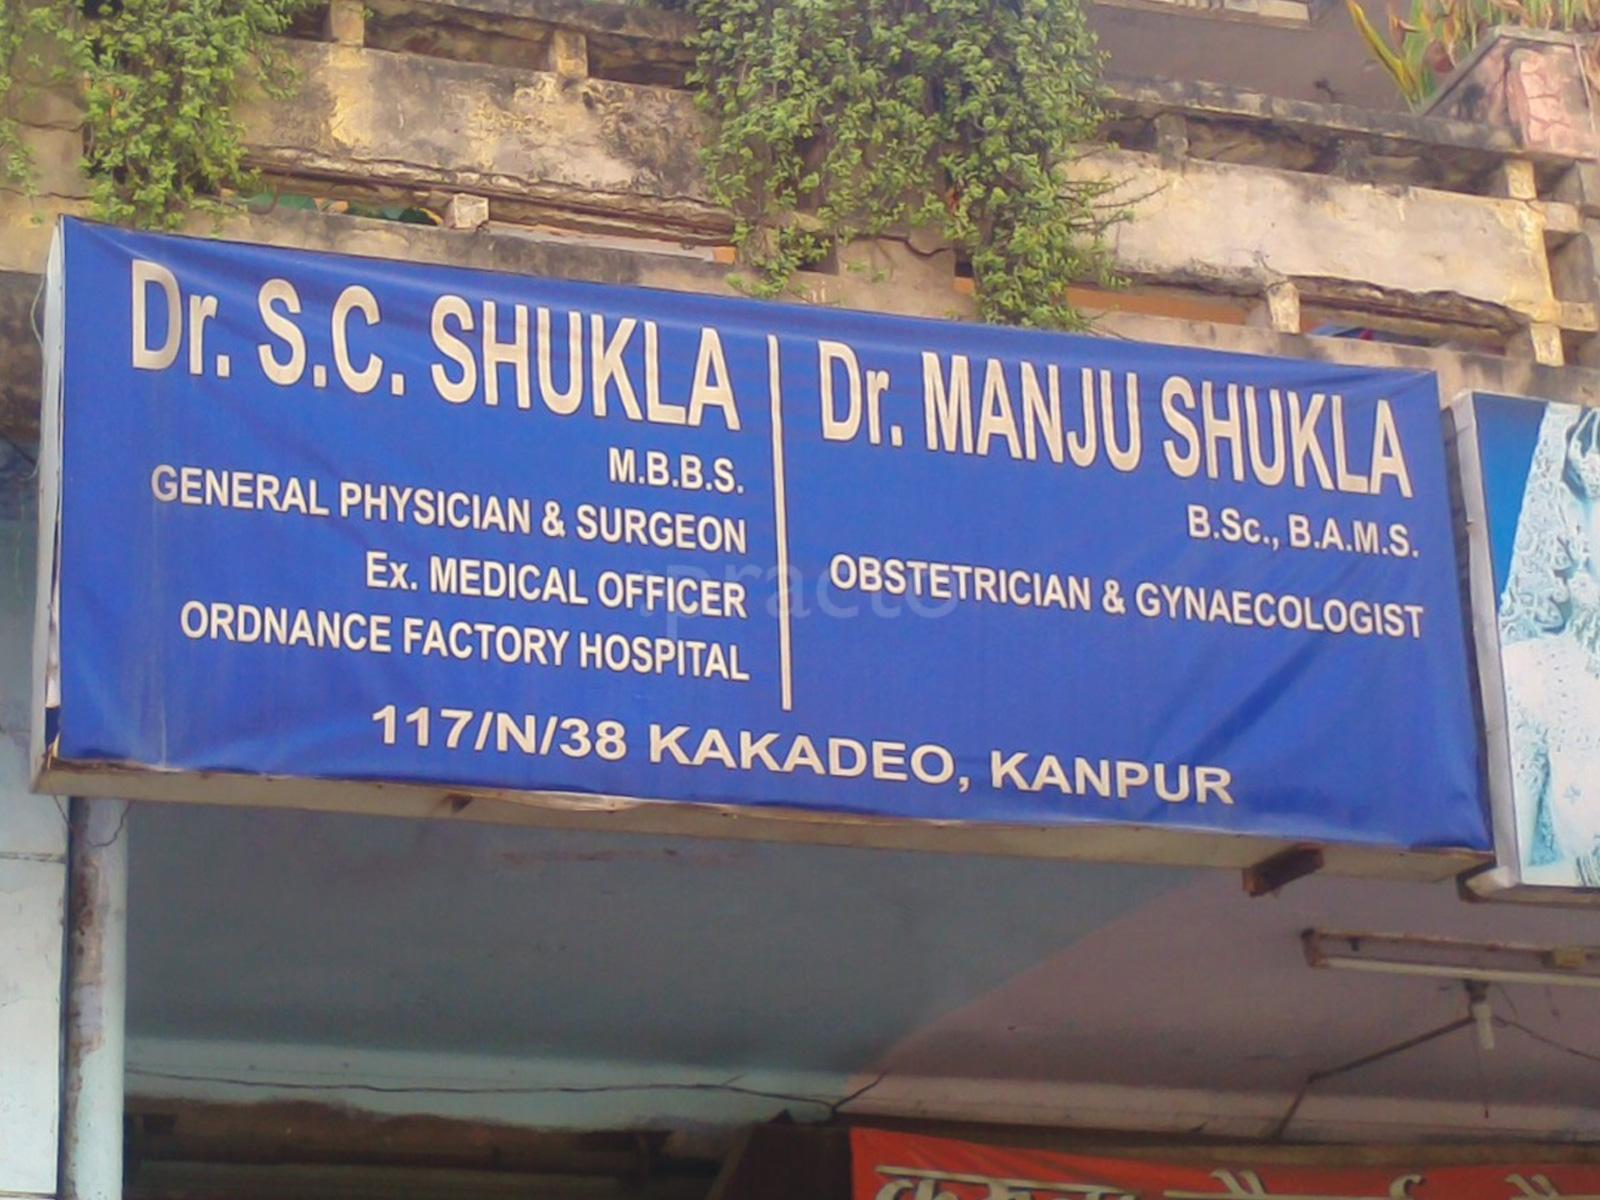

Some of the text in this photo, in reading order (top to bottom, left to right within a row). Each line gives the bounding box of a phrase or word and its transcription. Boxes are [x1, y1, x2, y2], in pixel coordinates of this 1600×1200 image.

[131, 258, 741, 431] Dr. S.C. SHUKLA
[817, 339, 1413, 498] Dr. MANJU SHUKLA
[151, 464, 747, 554] GENERAL PHYSICIAN & SURGEON
[609, 447, 745, 494] M.B.B.S.
[1187, 504, 1420, 558] B.Sc., B.A.M.S.
[366, 551, 748, 619] Ex. MEDICAL OFFICER
[830, 554, 1424, 638] OBSTETRICIAN & GYNAECOLOGIST
[180, 600, 750, 681] ORDNANCE FACTORY HOSPITAL
[372, 704, 1235, 804] 117/N/38 KAKADEO, KANPUR
